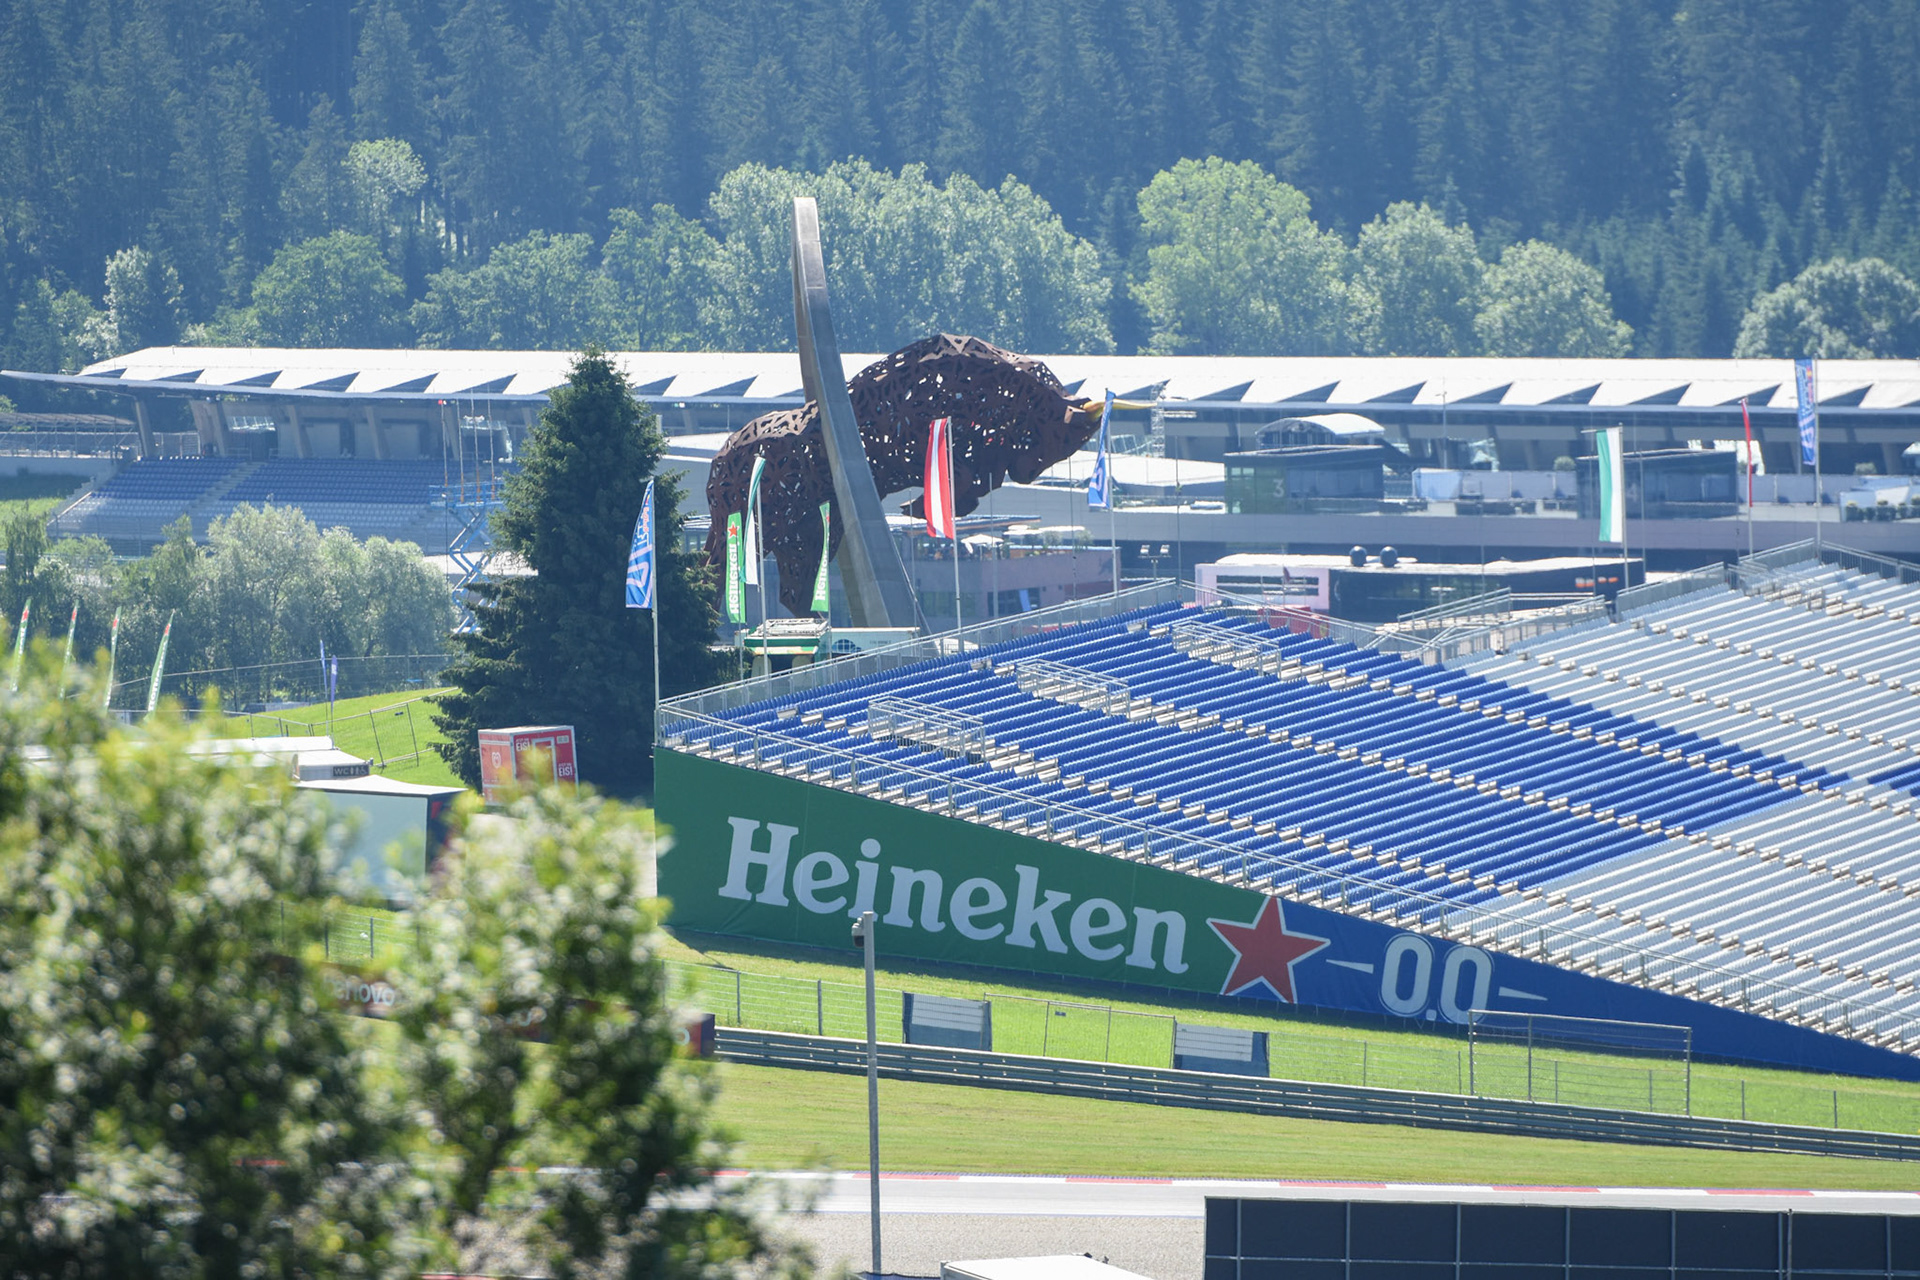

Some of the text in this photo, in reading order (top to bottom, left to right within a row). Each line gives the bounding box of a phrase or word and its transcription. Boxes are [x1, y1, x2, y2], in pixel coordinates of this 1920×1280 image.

[1273, 478, 1285, 498] 3
[728, 543, 740, 614] Heineken
[333, 767, 349, 775] WC
[558, 765, 573, 777] EIS!
[718, 816, 1495, 1025] Heineken 0.0
